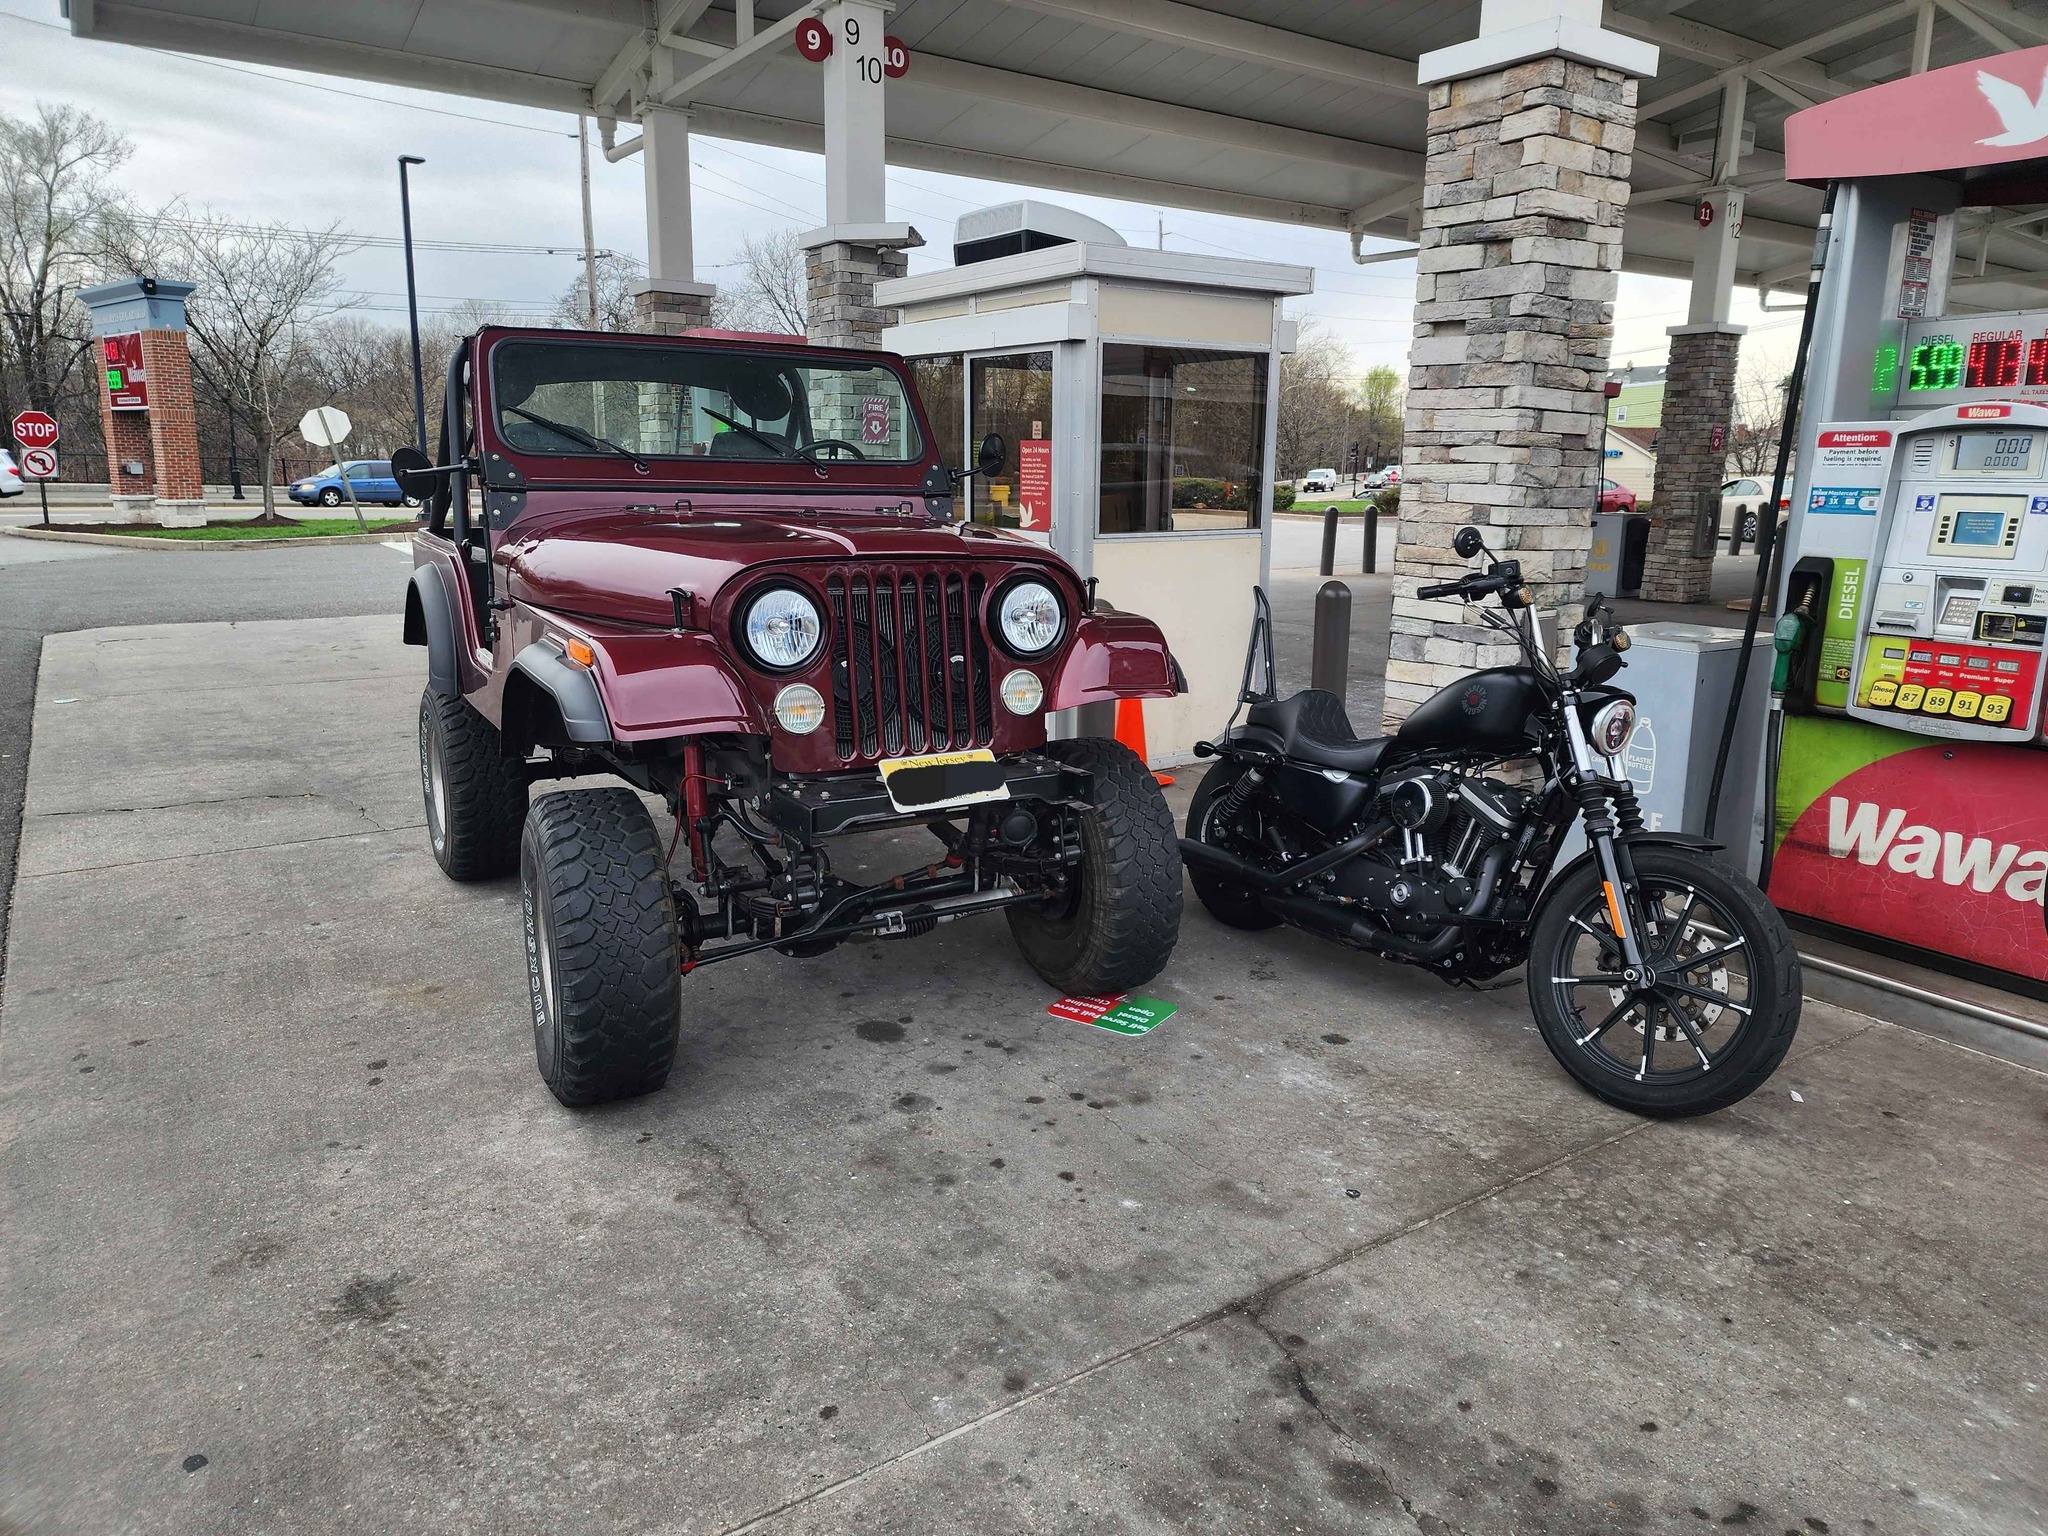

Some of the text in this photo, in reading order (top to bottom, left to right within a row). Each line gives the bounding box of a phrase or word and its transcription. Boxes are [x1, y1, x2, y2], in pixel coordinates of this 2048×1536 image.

[845, 18, 860, 45] 9
[807, 29, 821, 50] 9
[884, 46, 905, 68] 10
[856, 55, 882, 84] 10
[1700, 207, 1711, 221] 11
[1727, 201, 1738, 218] 11
[1730, 222, 1742, 239] 12
[1921, 334, 1956, 346] DIESEL
[1972, 329, 2023, 342] REGULAR
[868, 403, 884, 411] FIRE
[1968, 407, 2001, 418] Wawa
[17, 422, 55, 437] STOP
[1832, 433, 1879, 442] Attention:
[1995, 438, 2033, 454] 0.00
[1984, 456, 2019, 467] 0.000
[1838, 567, 1860, 620] DIESEL
[1881, 663, 1902, 671] Diesel
[1906, 666, 1931, 674] Regular
[1837, 669, 1850, 678] 40
[1959, 672, 1990, 681] Premium
[1993, 676, 2015, 684] Super
[1873, 685, 1896, 694] Diesel
[1902, 692, 1919, 703] 87
[1929, 696, 1946, 707] 89
[1957, 699, 1973, 710] 91
[1986, 703, 2004, 714] 93
[909, 757, 966, 768] New Jersey
[1629, 755, 1653, 764] PLASTIC
[1629, 761, 1653, 771] BOTTLES
[1828, 796, 2047, 907] Wawa
[522, 880, 546, 1027] BUCKSHOT
[1052, 1002, 1102, 1019] Full Serve
[1065, 998, 1107, 1012] Gasoline
[1128, 1006, 1156, 1017] Open
[1100, 1015, 1128, 1028] Serve
[1117, 1011, 1149, 1024] Diesel
